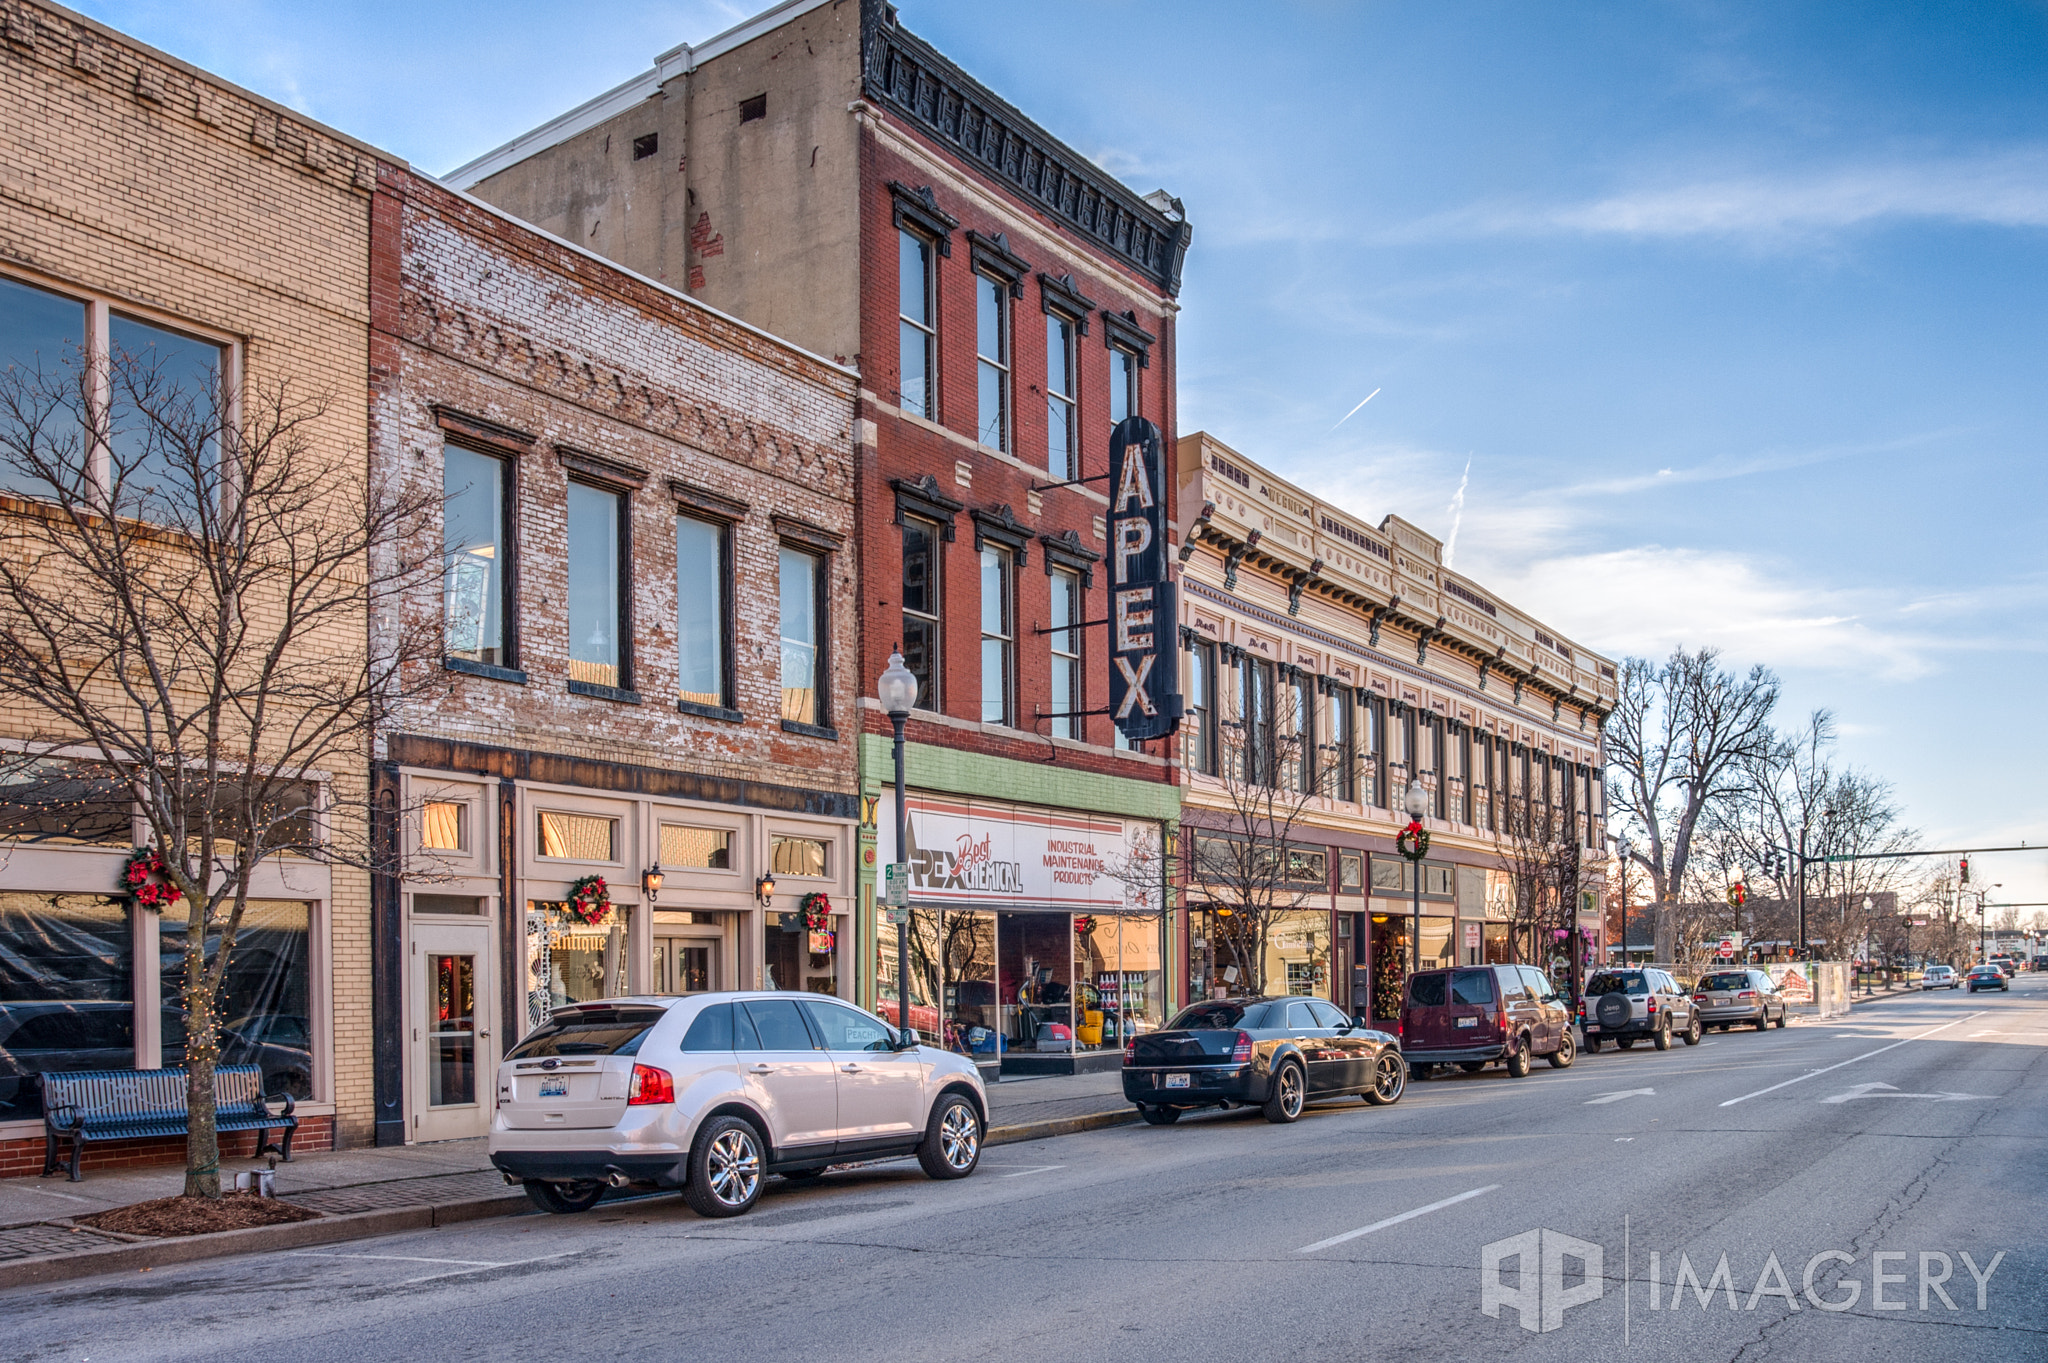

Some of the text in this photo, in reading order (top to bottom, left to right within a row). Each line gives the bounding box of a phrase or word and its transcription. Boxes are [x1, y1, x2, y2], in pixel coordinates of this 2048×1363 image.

[1113, 443, 1158, 719] APEX
[905, 810, 968, 889] APEX
[954, 831, 991, 873] Best
[1047, 839, 1097, 856] INDUSTRIAL
[886, 866, 892, 878] 2
[1042, 854, 1105, 872] MAINTENANCE
[964, 861, 1024, 893] CHEMICAL
[1053, 870, 1093, 886] PRODUCTS
[548, 929, 606, 954] Antique
[1604, 1004, 1620, 1012] Jeep
